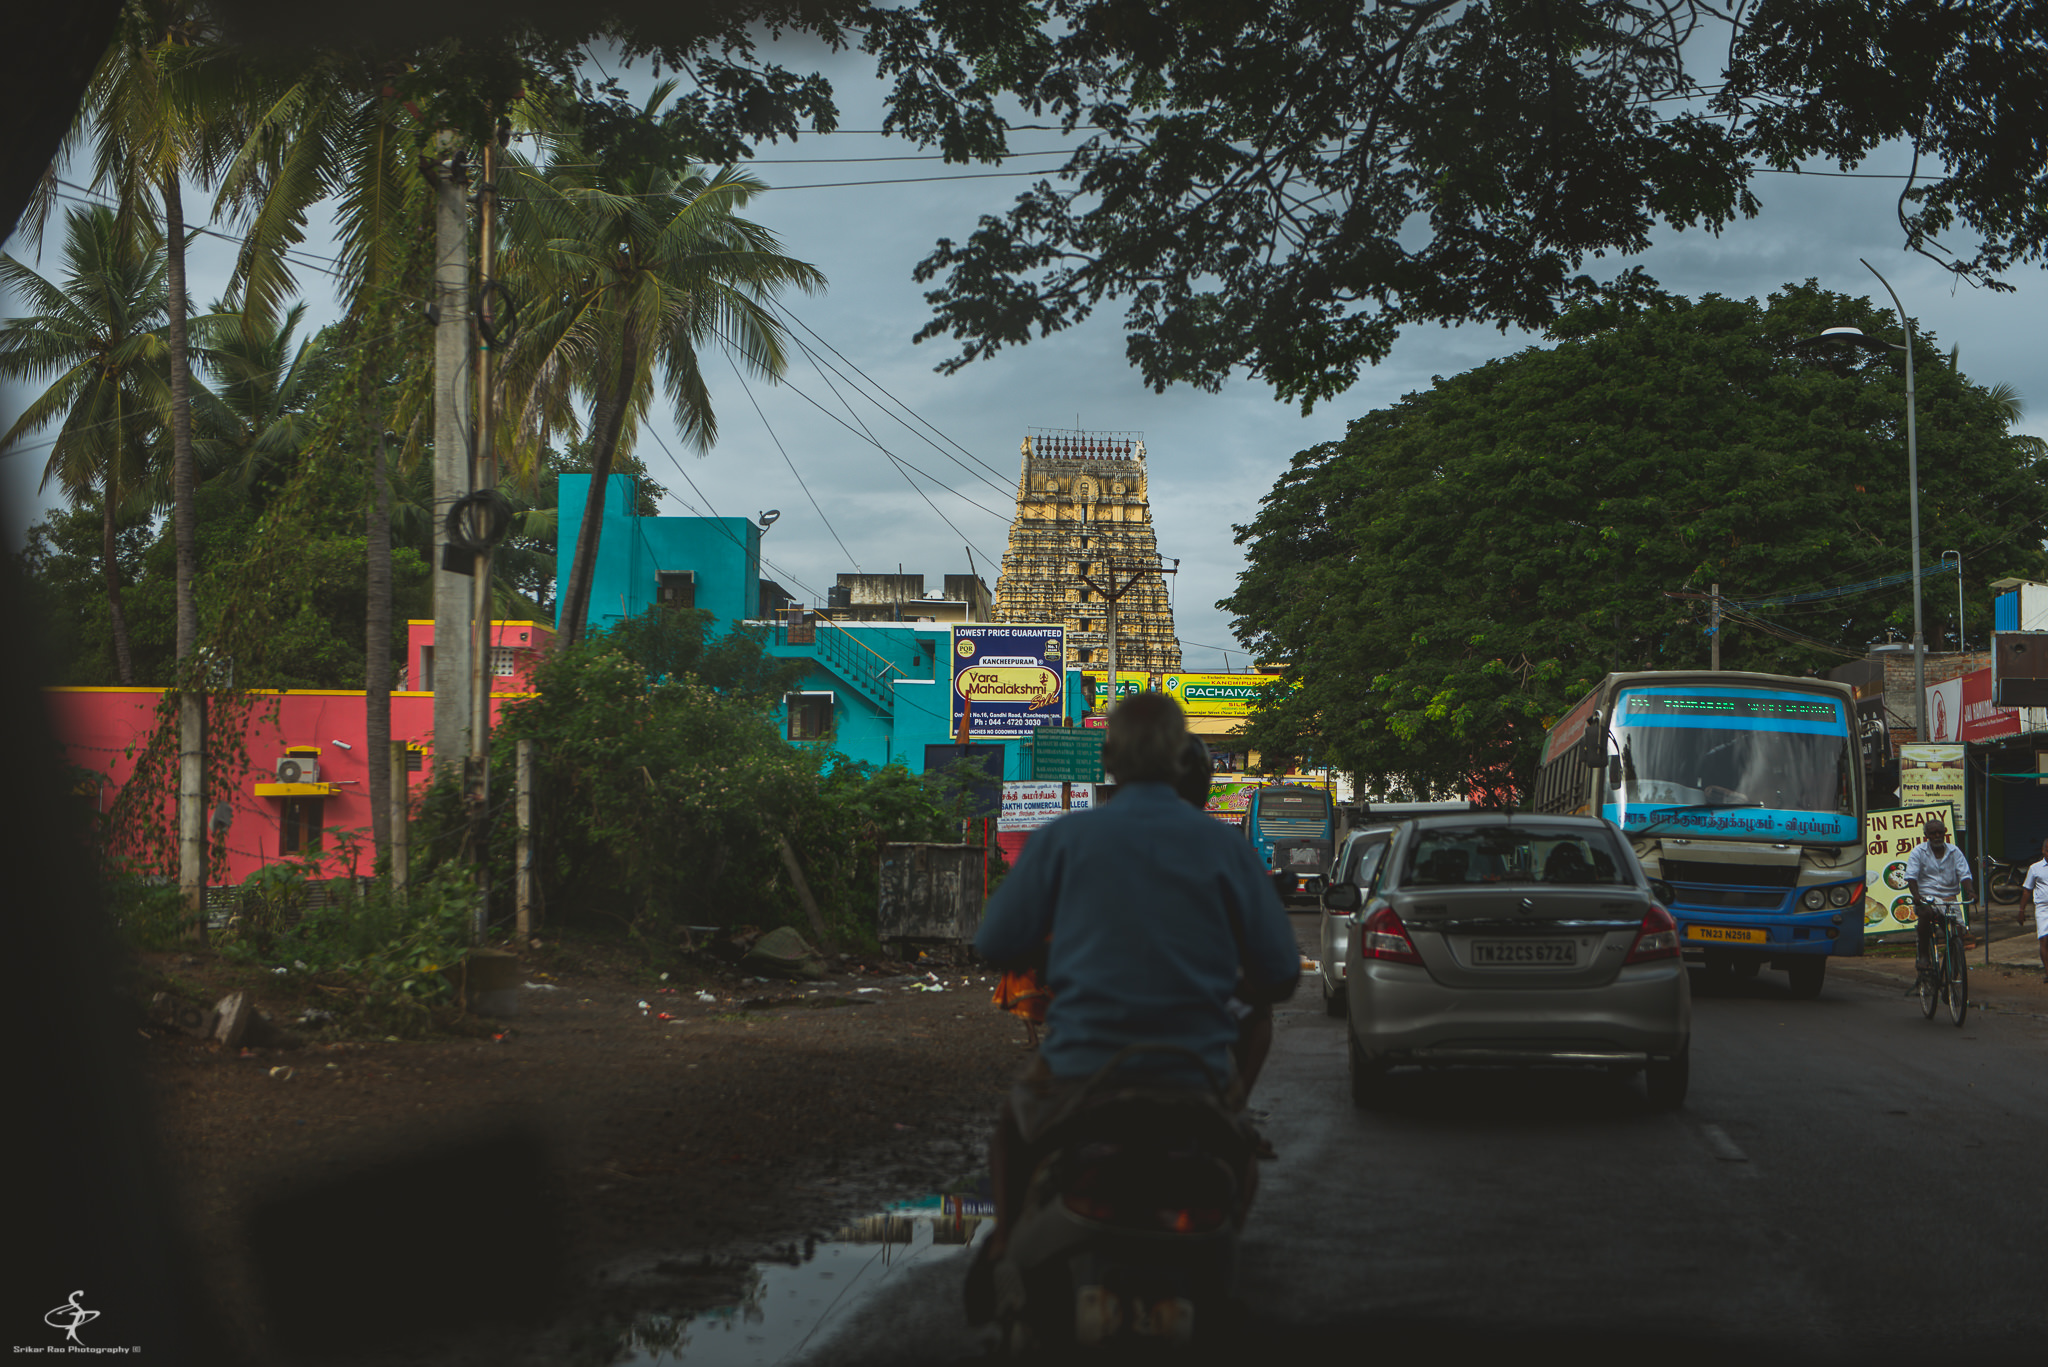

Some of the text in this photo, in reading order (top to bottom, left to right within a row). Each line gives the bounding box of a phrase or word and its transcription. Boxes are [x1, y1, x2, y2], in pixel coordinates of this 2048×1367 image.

[956, 629, 1062, 637] LOWEST PRICE GUARANTEED
[959, 645, 973, 653] PQR
[969, 672, 998, 683] Vara
[969, 683, 1047, 695] Mahalakshmi
[1029, 691, 1060, 711] Silks
[1903, 784, 1919, 792] Party
[1024, 801, 1062, 809] COMMERCIAL
[1700, 929, 1751, 940] TN23 N2518
